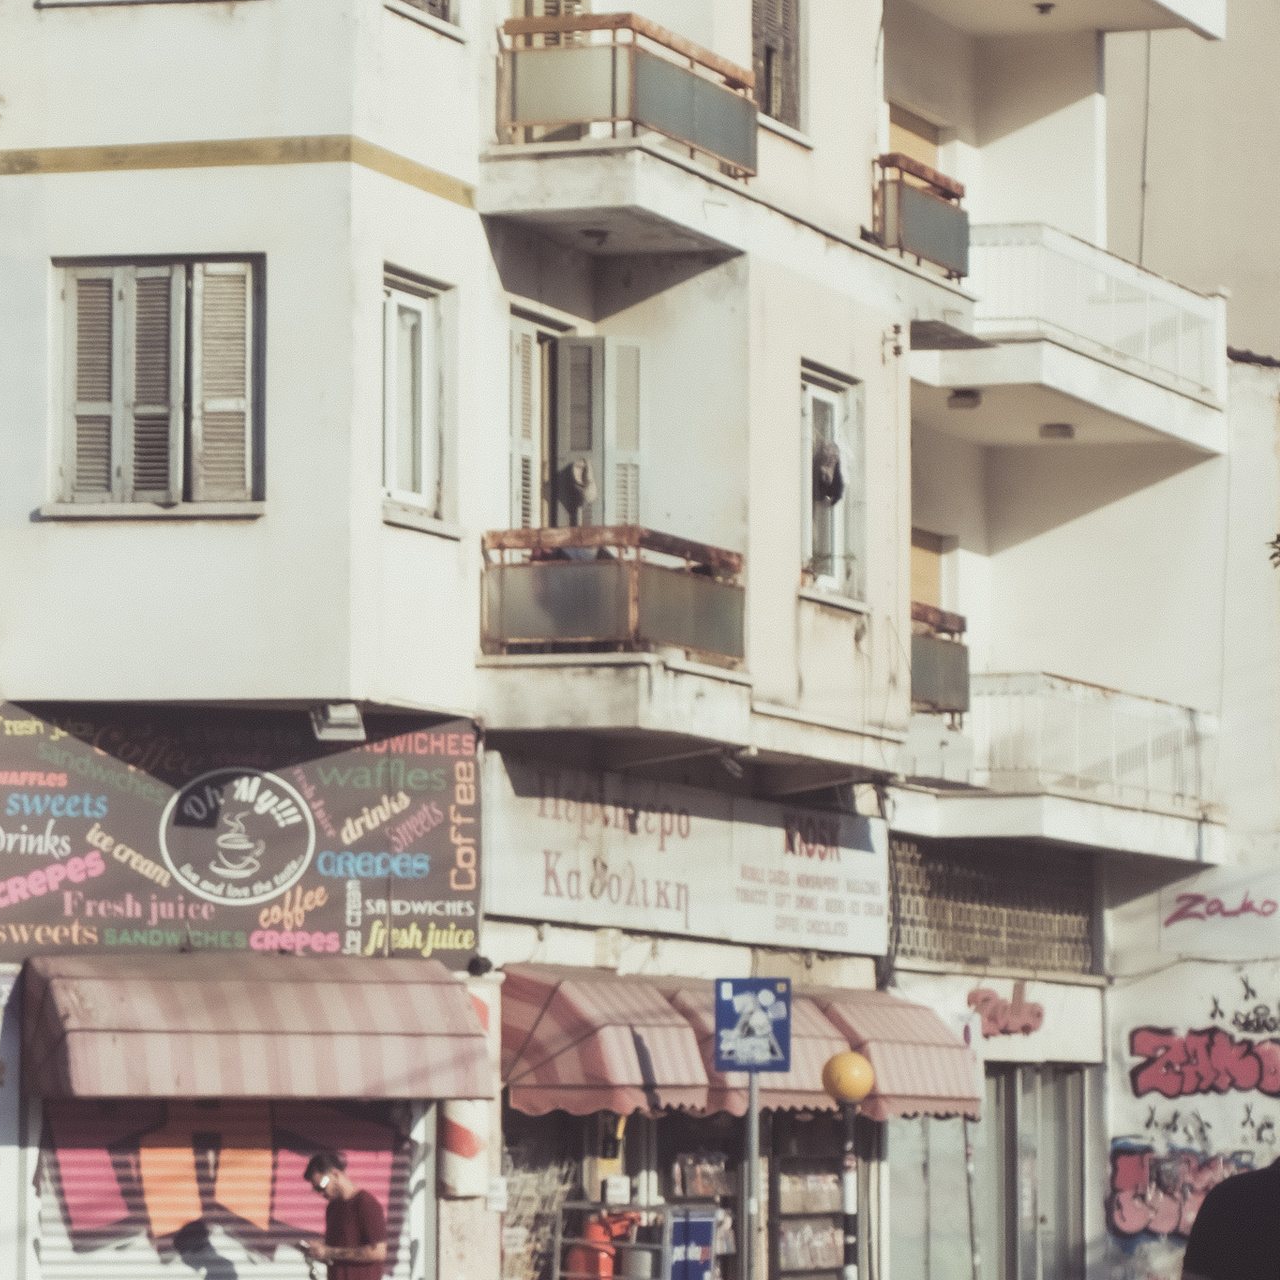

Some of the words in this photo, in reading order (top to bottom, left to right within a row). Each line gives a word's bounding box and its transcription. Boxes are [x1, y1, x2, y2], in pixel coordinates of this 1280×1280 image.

[316, 757, 448, 791] waffles
[4, 793, 109, 819] sweets
[341, 790, 411, 846] drinks
[449, 760, 477, 891] Coffee
[63, 890, 142, 918] Fresh
[147, 892, 216, 926] juice
[259, 885, 329, 931] coffee
[102, 927, 248, 949] SANDWCHES
[421, 921, 476, 958] juice
